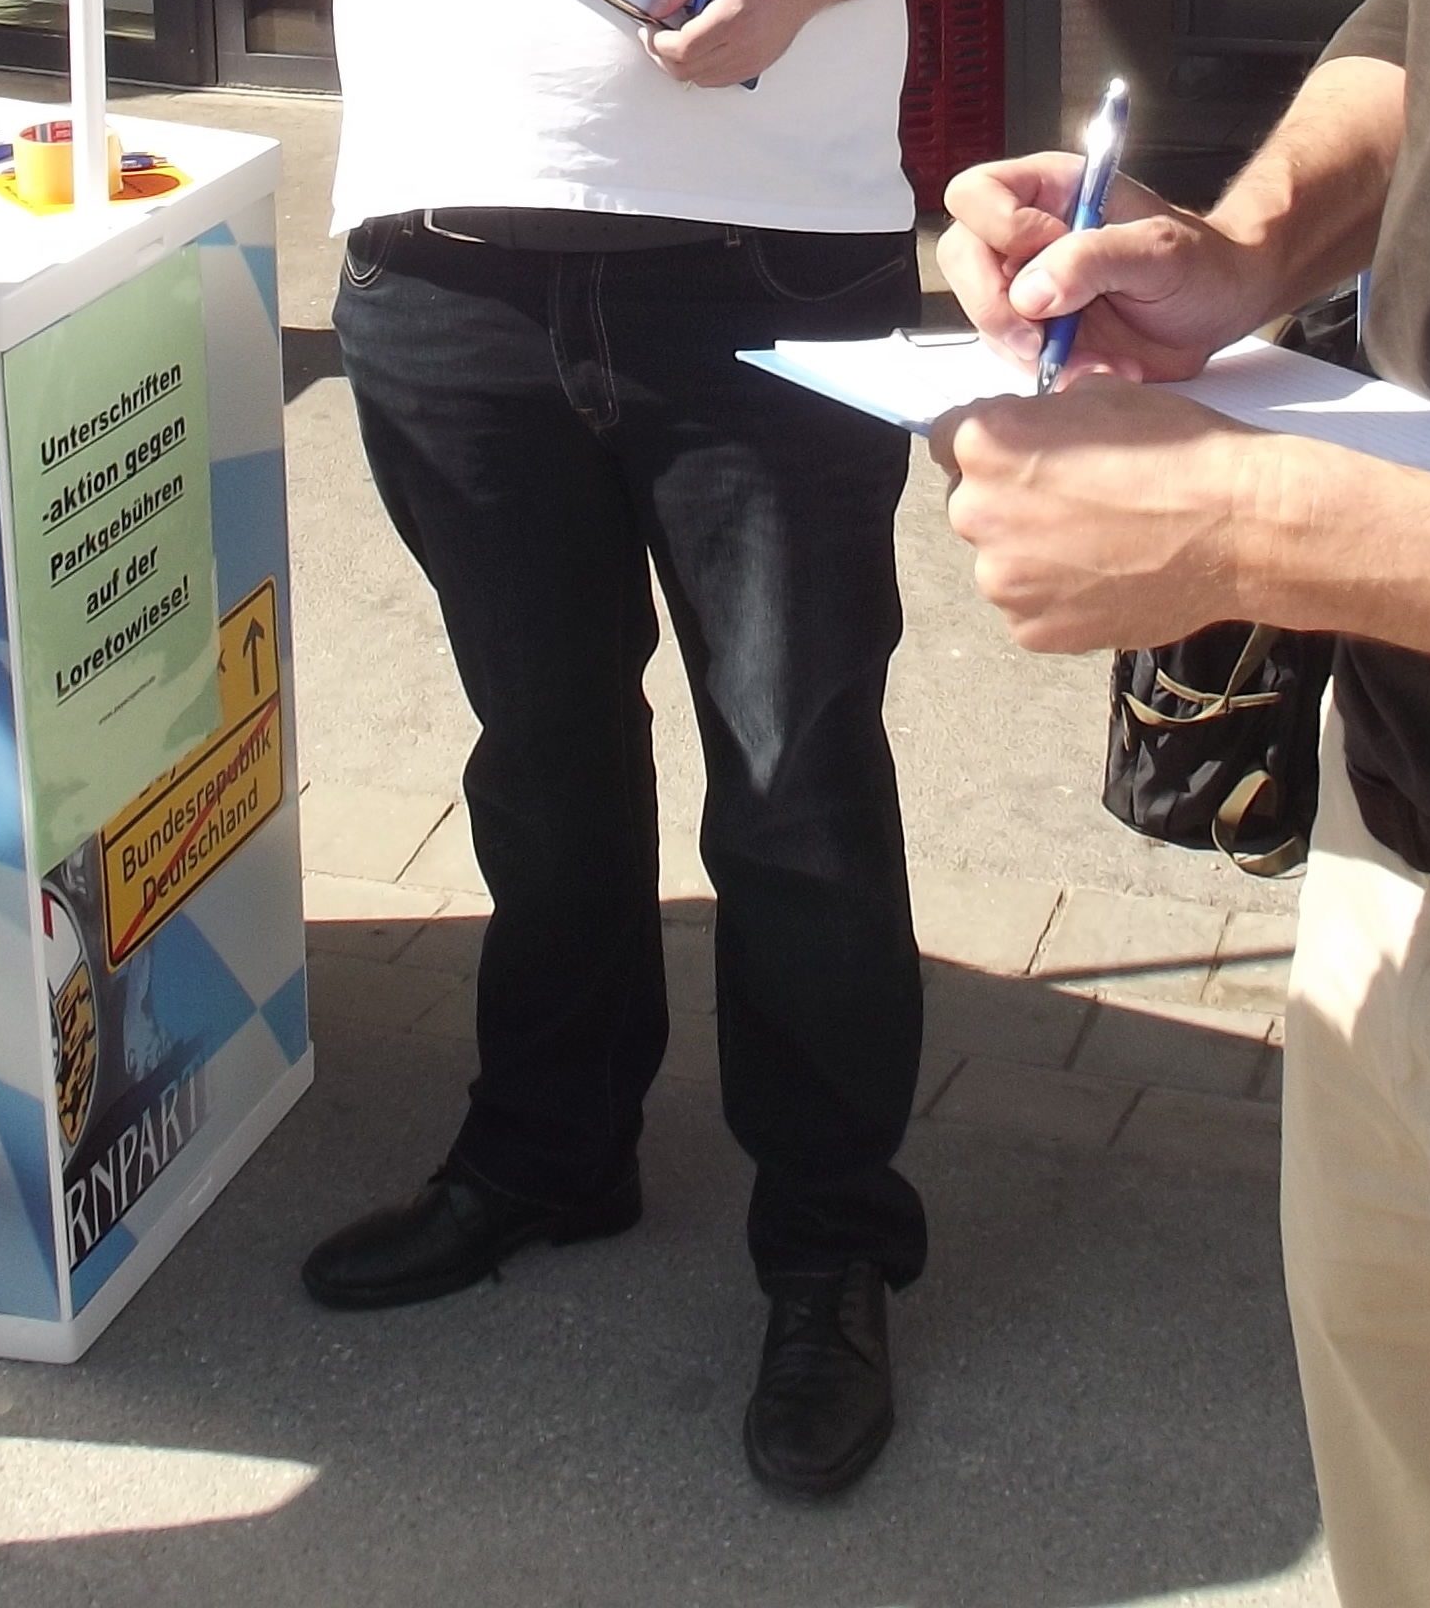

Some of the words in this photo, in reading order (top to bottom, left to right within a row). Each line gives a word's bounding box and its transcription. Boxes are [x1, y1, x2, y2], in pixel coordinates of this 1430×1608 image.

[41, 364, 182, 466] Unterschriften
[42, 462, 119, 523] -aktion
[125, 416, 186, 480] gegen
[50, 474, 184, 581] Parkgebühren
[86, 568, 120, 616] auf
[125, 545, 158, 586] der
[55, 574, 189, 698] Loretowiese!
[122, 728, 271, 883] Bundesrepublik
[142, 778, 259, 911] Deutschland
